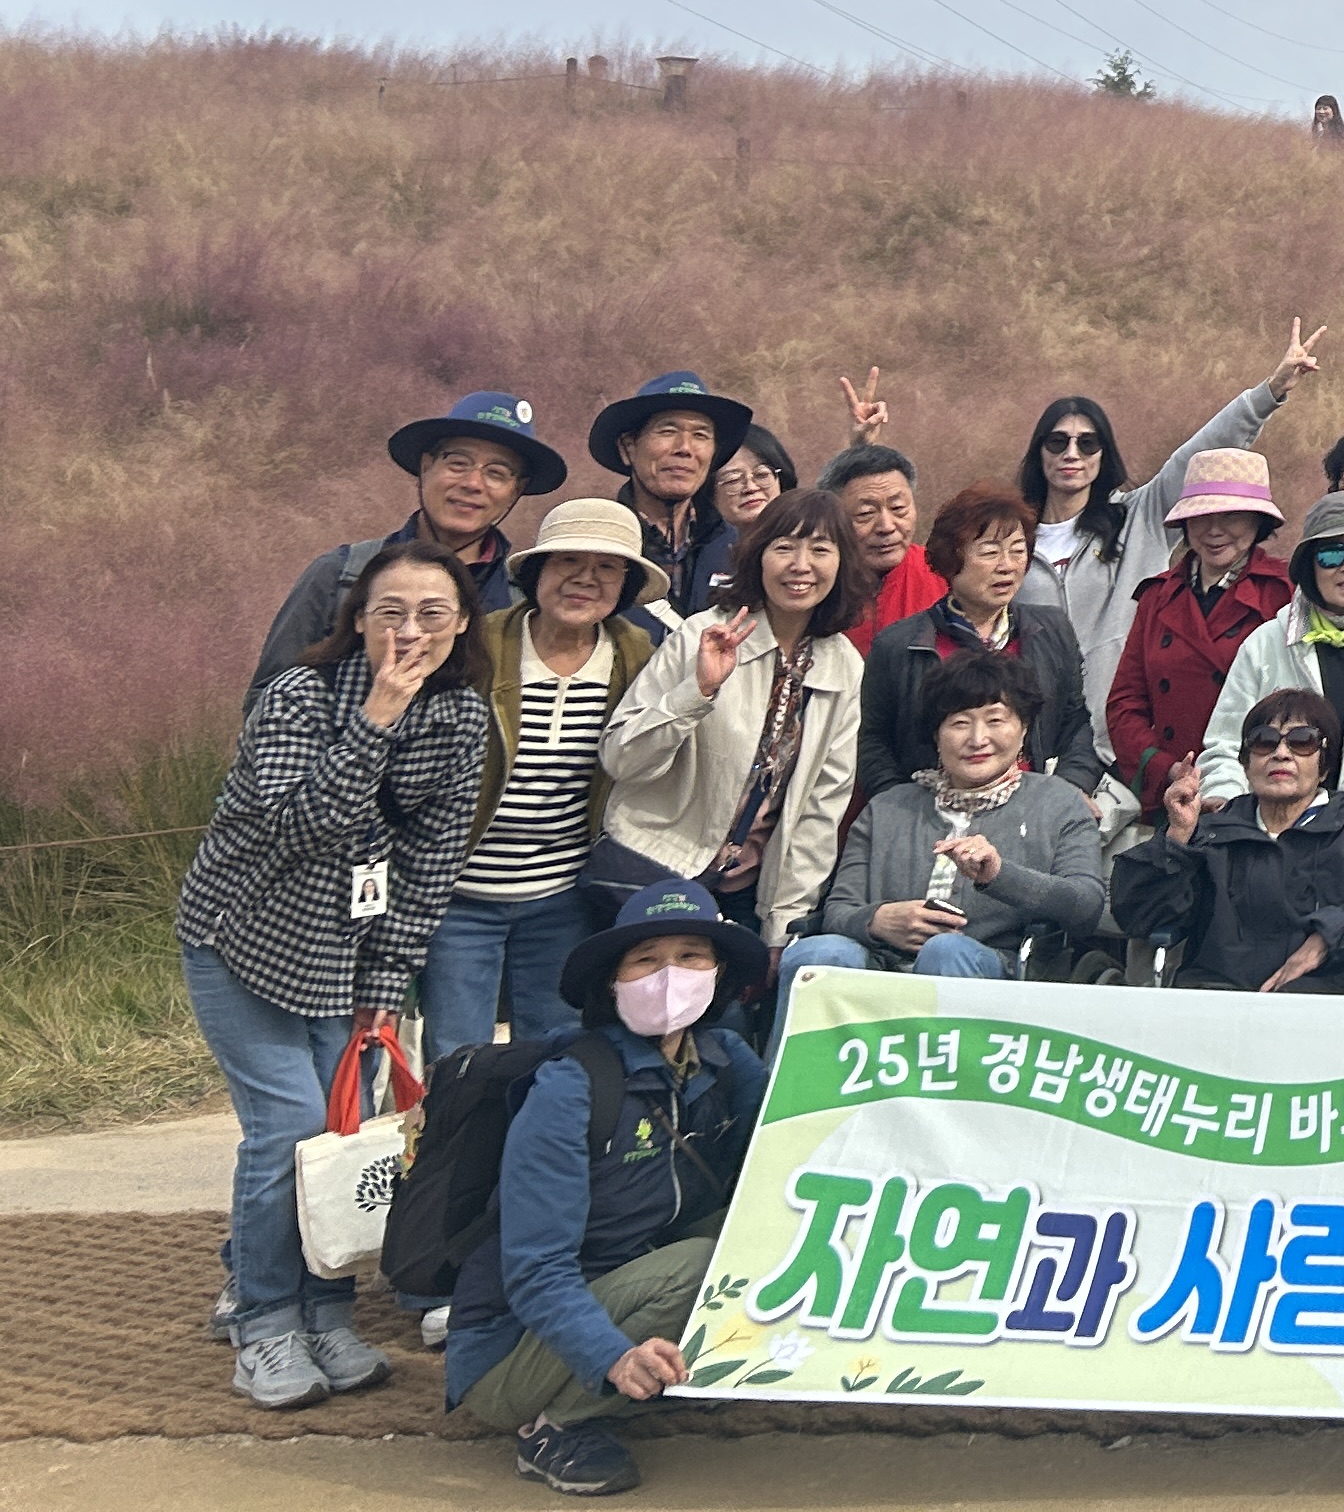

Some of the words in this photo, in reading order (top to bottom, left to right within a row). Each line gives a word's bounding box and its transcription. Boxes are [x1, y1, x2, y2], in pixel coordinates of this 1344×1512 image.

[838, 1028, 960, 1095] 25년
[980, 1032, 1271, 1155] 경남생태누리
[755, 1171, 1137, 1339] 자연과
